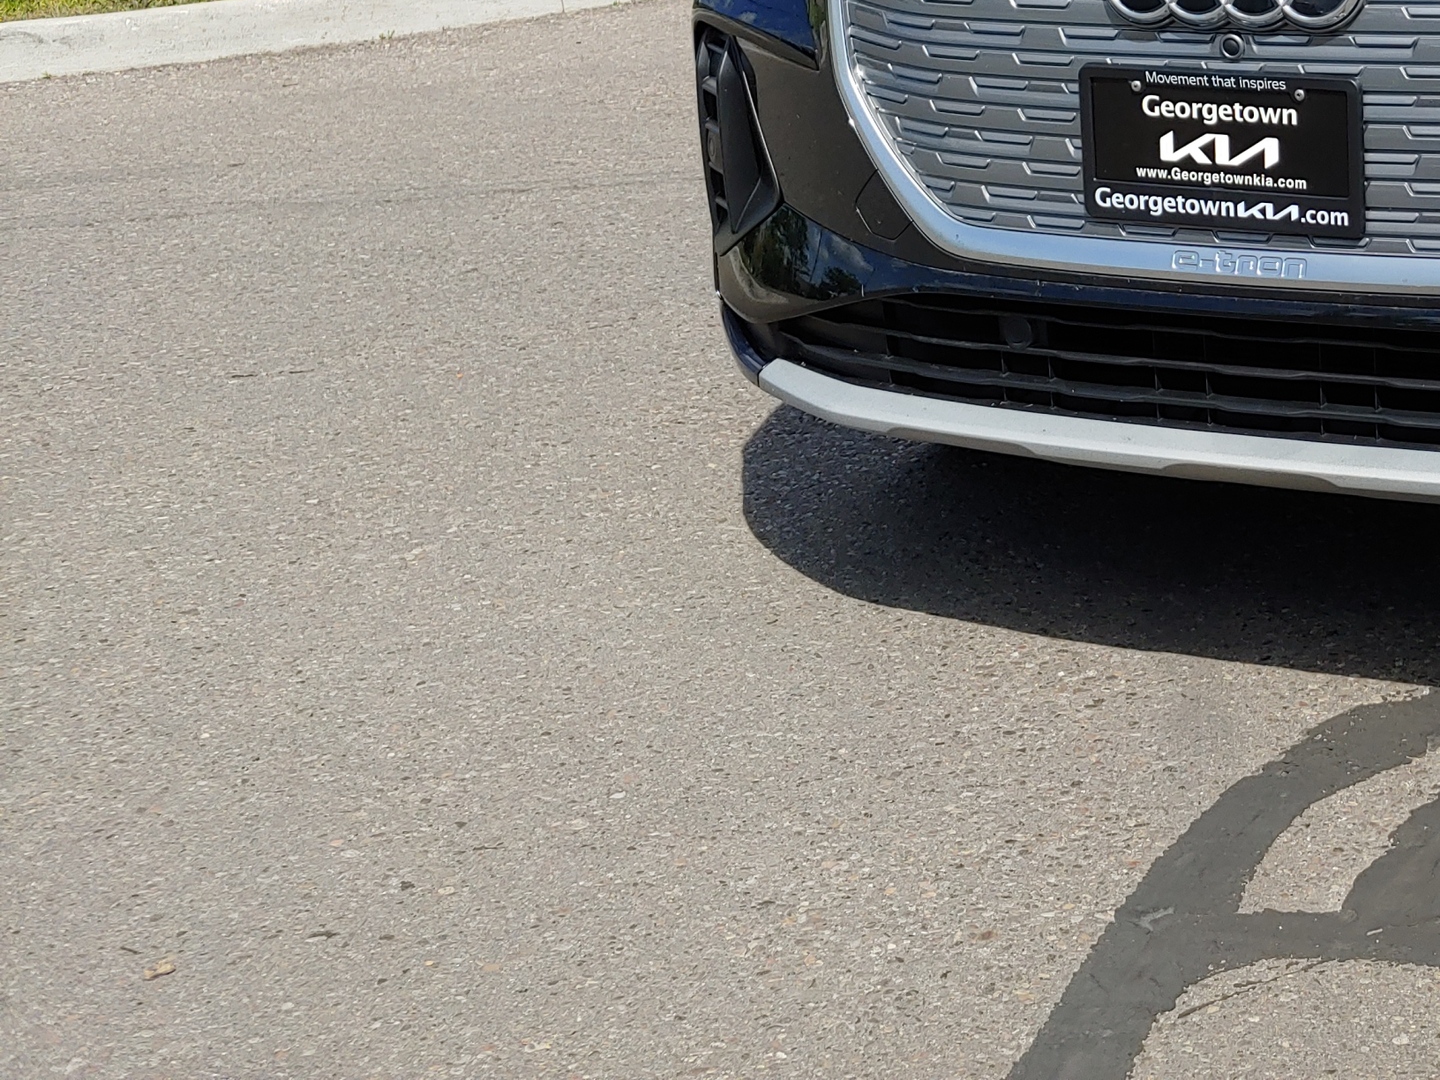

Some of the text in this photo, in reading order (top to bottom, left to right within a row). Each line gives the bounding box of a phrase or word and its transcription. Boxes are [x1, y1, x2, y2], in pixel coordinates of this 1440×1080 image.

[1145, 71, 1287, 92] Movement that inspires
[1141, 95, 1298, 125] Georgetown
[1135, 167, 1307, 190] www.Georgetownkia.com
[1171, 249, 1308, 278] e-tron
